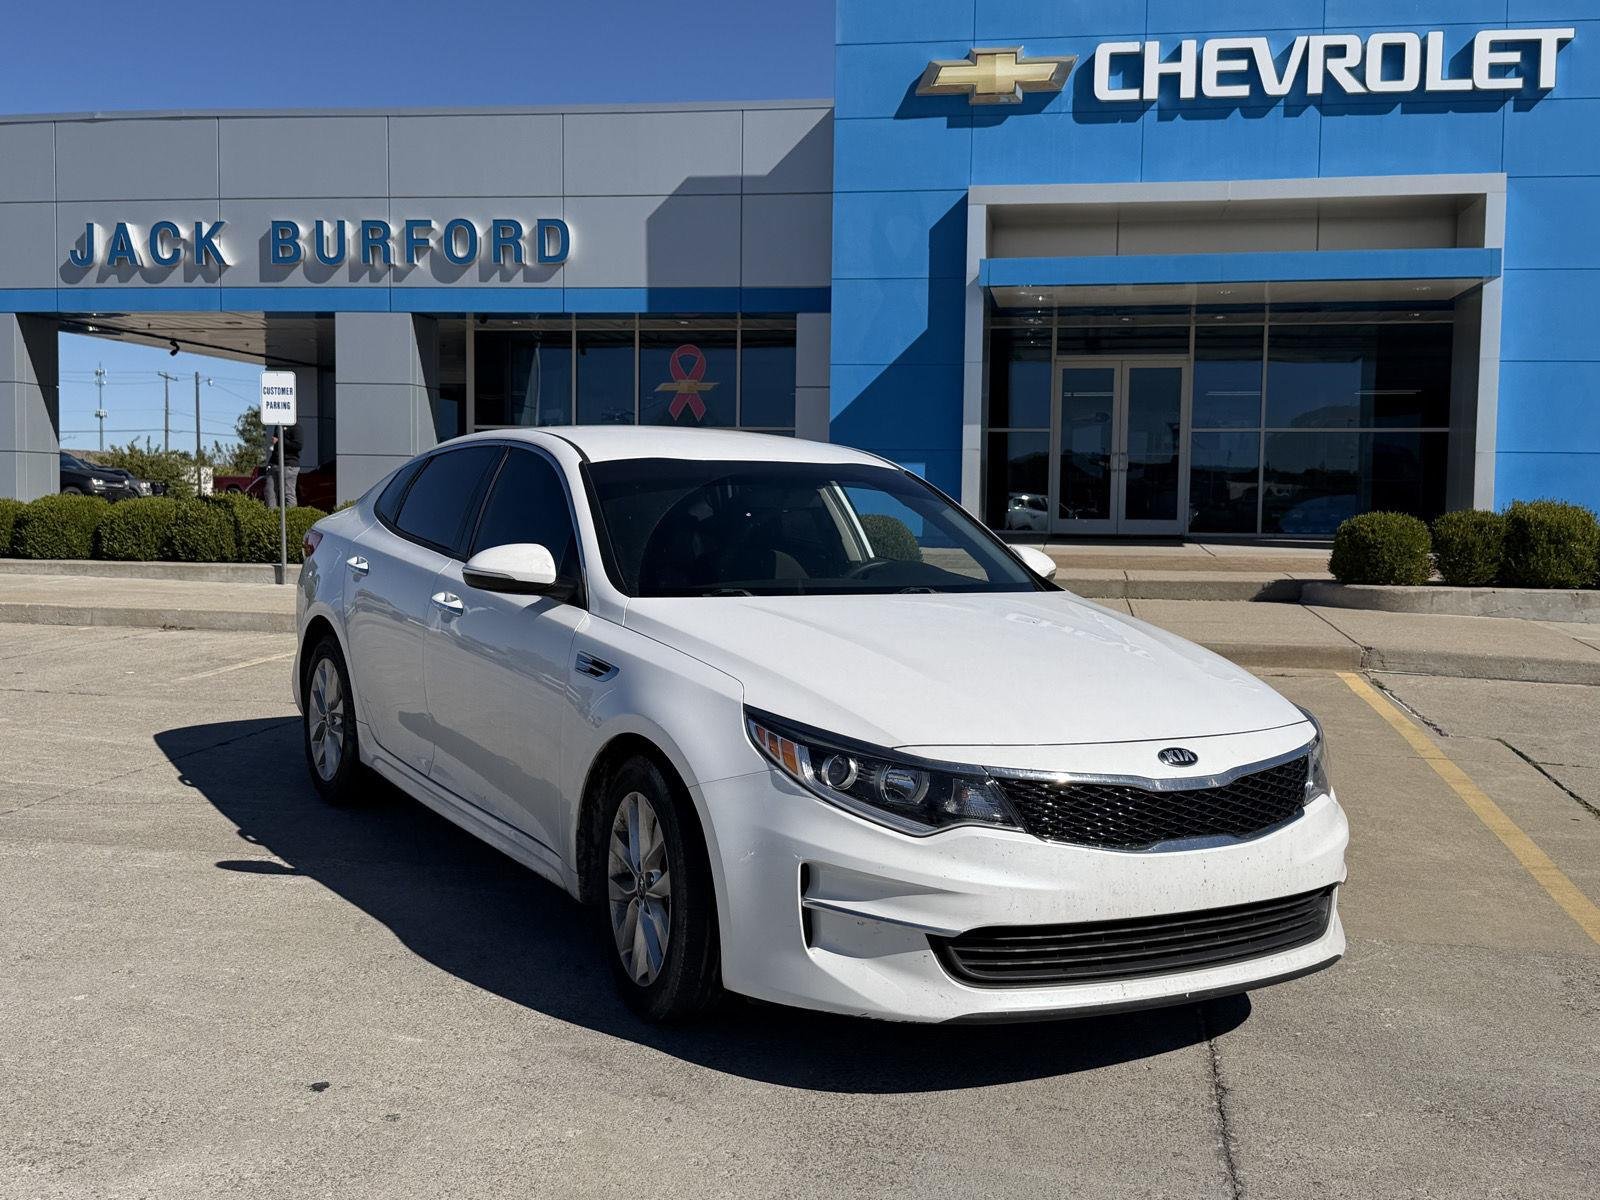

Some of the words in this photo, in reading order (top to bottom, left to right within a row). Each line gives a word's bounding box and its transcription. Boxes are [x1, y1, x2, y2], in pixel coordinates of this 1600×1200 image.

[1093, 27, 1576, 103] CHEVROLET
[69, 220, 229, 268] JACK
[270, 218, 572, 267] BURFORD
[262, 386, 294, 396] CUSTOMER
[265, 401, 291, 410] PARKING
[1163, 749, 1195, 763] KIA
